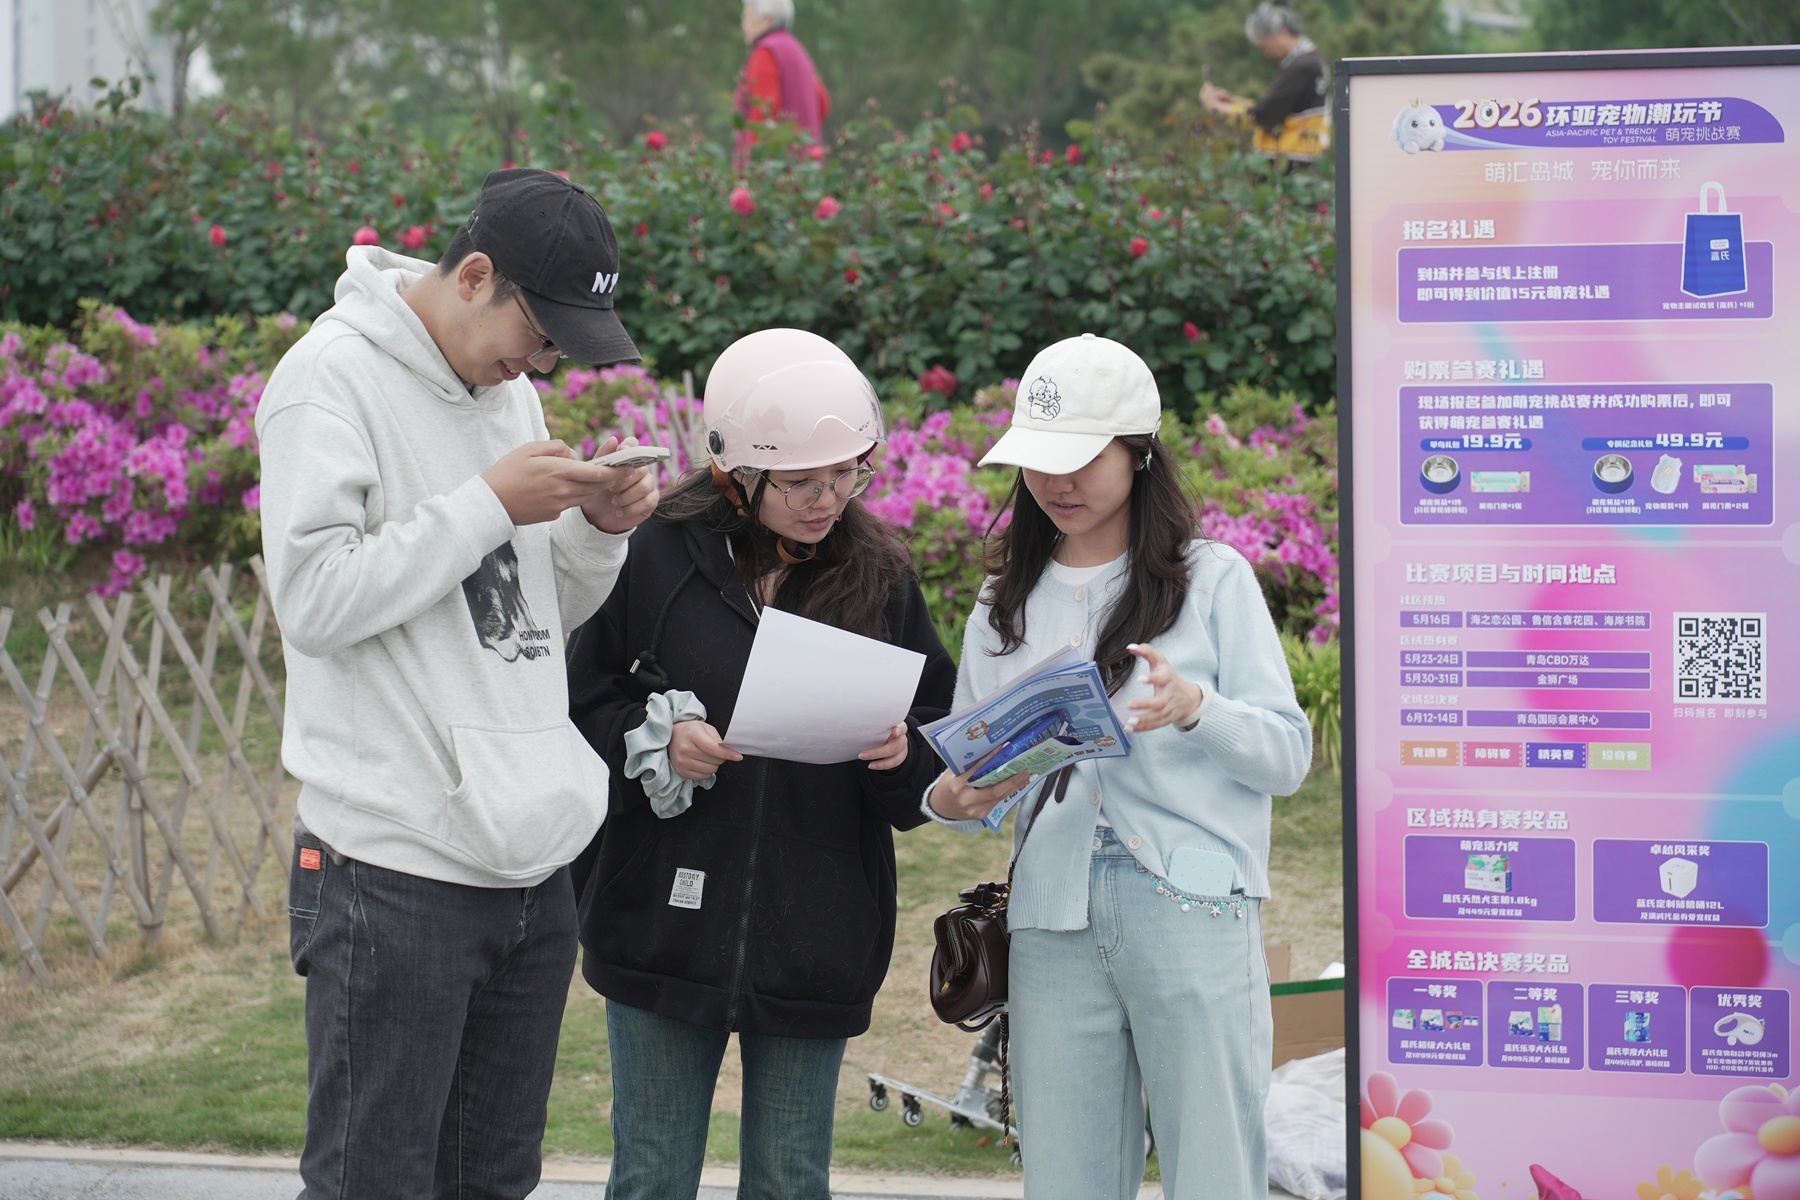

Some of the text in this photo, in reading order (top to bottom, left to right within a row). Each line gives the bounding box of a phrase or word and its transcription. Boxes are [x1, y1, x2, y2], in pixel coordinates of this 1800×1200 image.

[1453, 98, 1723, 130] 2026 环亚宠物潮玩节
[1600, 128, 1616, 136] PET
[1617, 128, 1623, 136] &
[1625, 127, 1658, 135] TRENDY
[1665, 125, 1741, 142] 萌宠挑战赛
[1620, 136, 1657, 144] FESTIVAL
[1484, 158, 1681, 183] 萌汇岛城 宠你而来
[1402, 220, 1496, 241] 报名礼遇
[1417, 266, 1559, 281] 到场并参与线上注册
[1417, 285, 1610, 301] 即可得到价值15元萌宠礼遇
[1404, 359, 1545, 380] 购票参赛礼遇
[1418, 415, 1544, 430] 获得萌宠参赛礼遇
[1462, 433, 1522, 449] 19.9元
[1656, 432, 1723, 448] 49.9元
[1405, 563, 1617, 585] 比赛项目与时间地点
[1400, 594, 1446, 606] 社区预热
[1413, 614, 1450, 626] 5月16日
[1470, 614, 1646, 627] 海之恋公园、鲁信含章花园、海岸书院
[1400, 635, 1458, 647] 区域热身赛
[1405, 653, 1459, 665] 5月23-24日
[1526, 654, 1590, 667] 青岛CBD万达
[1405, 673, 1459, 685] 5月30-31日
[1537, 673, 1578, 686] 金狮广场
[1400, 693, 1458, 705] 全城总决赛
[1406, 712, 1458, 724] 6月12-14日
[1673, 707, 1767, 718] 扫码报名 即刻参与
[1516, 714, 1599, 726] 青岛国际会展中心
[1412, 746, 1448, 759] 竞速赛
[1475, 748, 1511, 760] 障碍赛
[1537, 748, 1574, 761] 精英赛
[1407, 808, 1569, 830] 区域热身赛奖品
[1460, 840, 1519, 852] 萌宠活力奖
[1650, 844, 1710, 857] 卓越风采奖
[1406, 949, 1570, 974] 全城总决赛奖品
[1413, 984, 1457, 998] 一等奖
[1514, 987, 1557, 1001] 二等奖
[1615, 990, 1659, 1004] 三等奖
[1717, 993, 1762, 1008] 优秀奖
